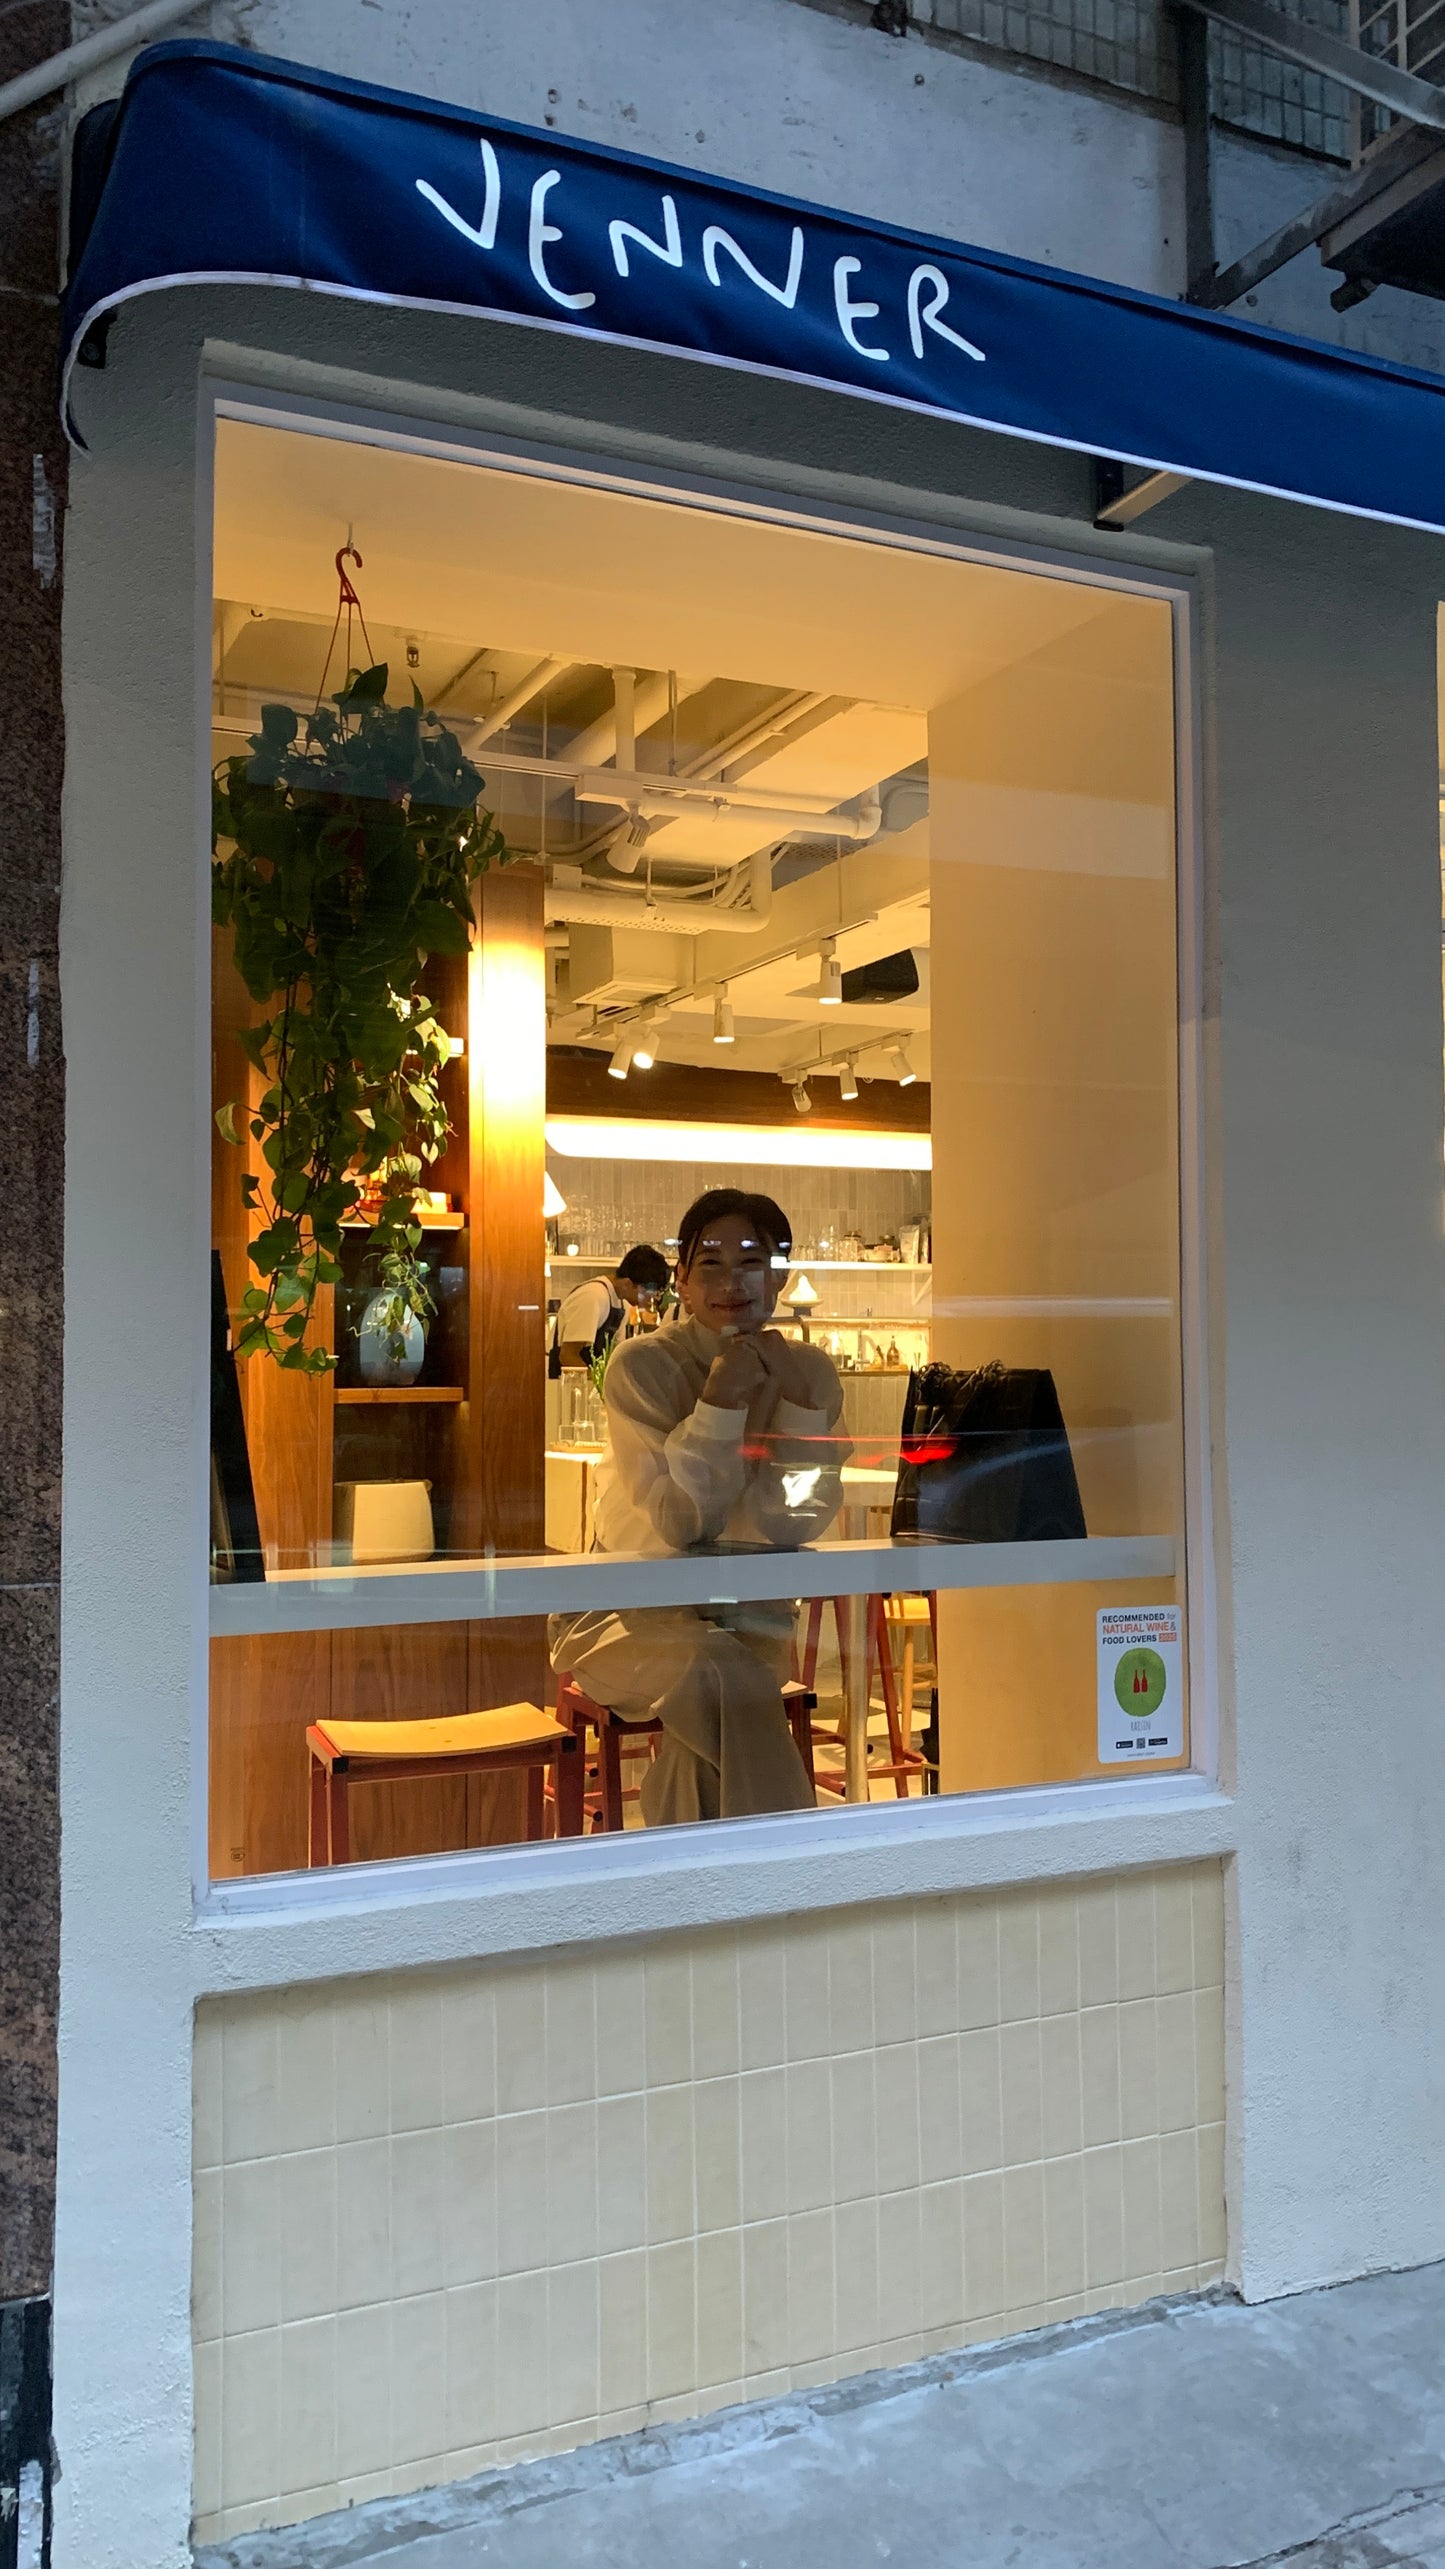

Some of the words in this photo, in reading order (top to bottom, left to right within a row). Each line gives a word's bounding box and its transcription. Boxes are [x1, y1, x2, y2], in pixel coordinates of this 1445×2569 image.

[415, 138, 986, 362] VENNER
[1102, 1613, 1165, 1623] RECOMMENDED
[1103, 1624, 1144, 1634] NATURAL
[1146, 1622, 1169, 1632] WINE
[1170, 1622, 1176, 1631] &
[1102, 1636, 1124, 1645] FOOD
[1126, 1634, 1157, 1644] LOVERS
